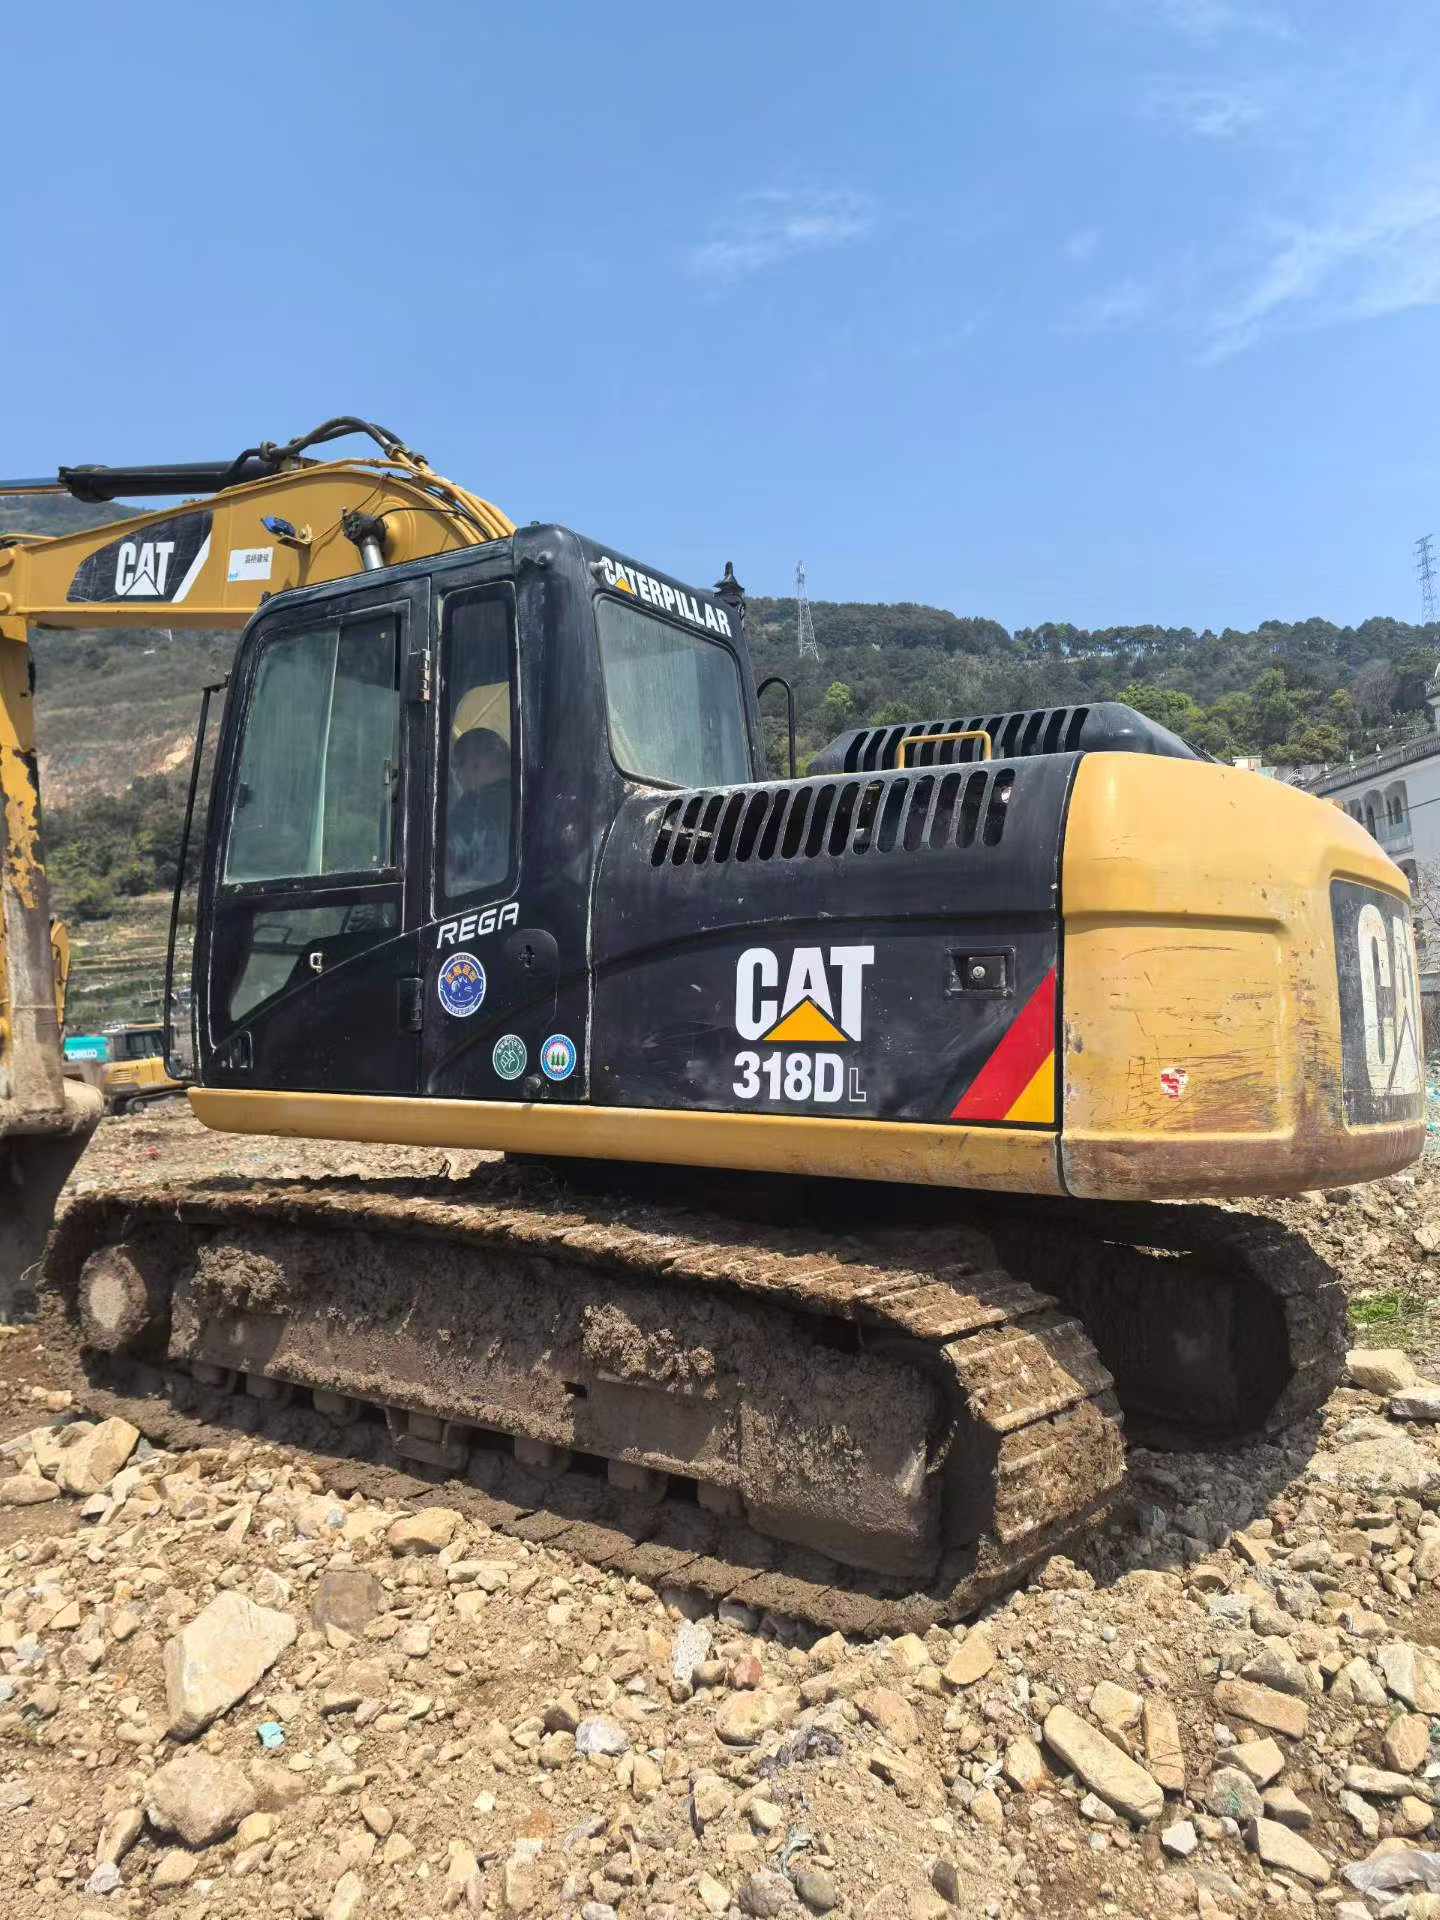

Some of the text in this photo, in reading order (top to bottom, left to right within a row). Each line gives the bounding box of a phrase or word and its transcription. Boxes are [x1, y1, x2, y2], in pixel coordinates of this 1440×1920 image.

[115, 541, 175, 595] CAT
[601, 556, 732, 638] CATERPILLAR
[436, 902, 520, 949] REGA
[735, 945, 875, 1042] CAT
